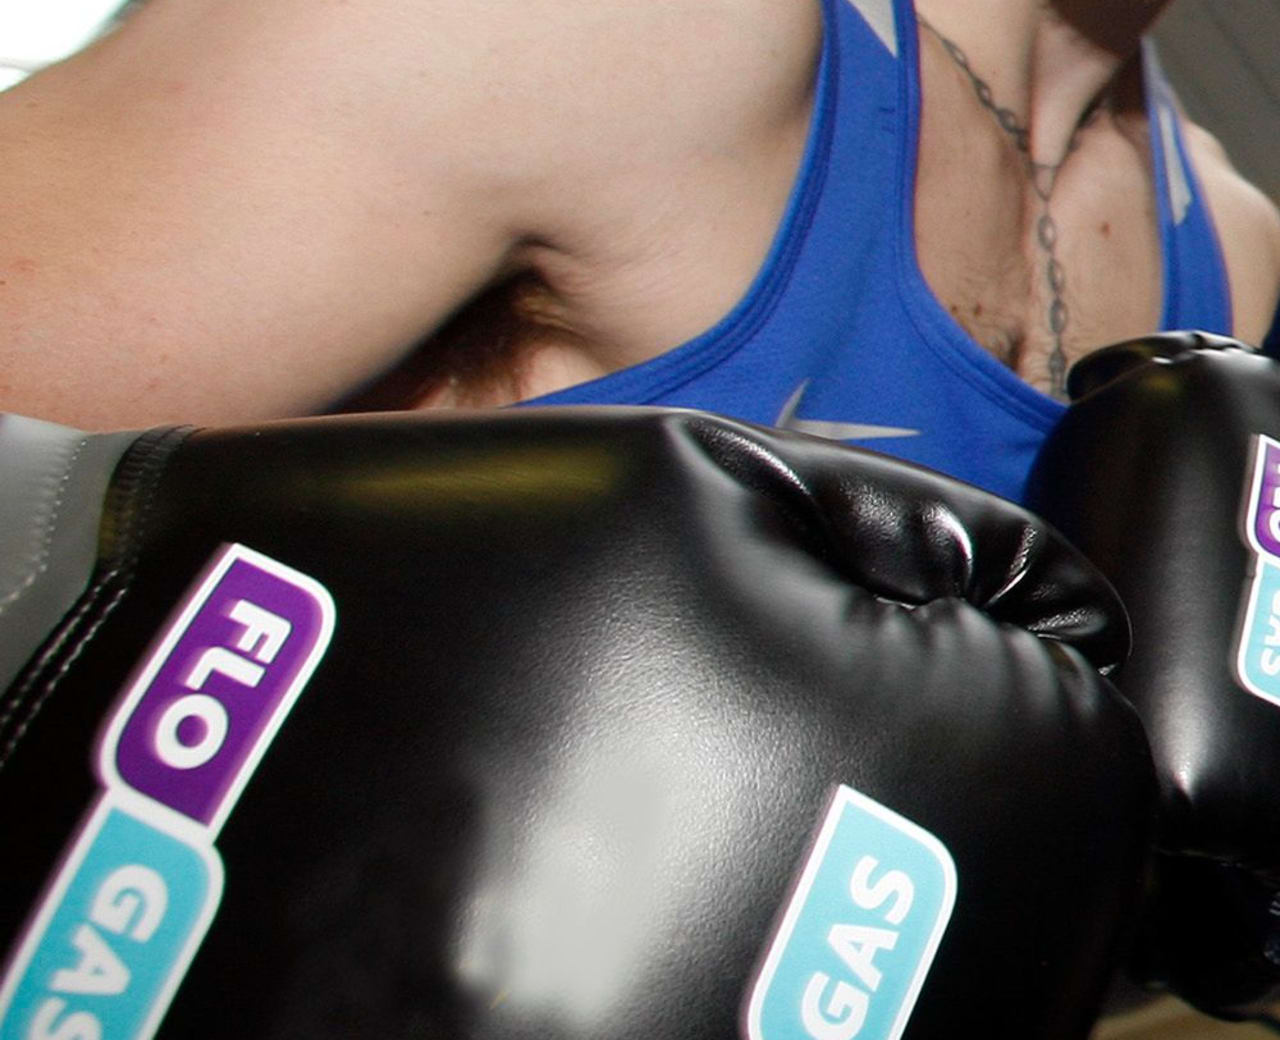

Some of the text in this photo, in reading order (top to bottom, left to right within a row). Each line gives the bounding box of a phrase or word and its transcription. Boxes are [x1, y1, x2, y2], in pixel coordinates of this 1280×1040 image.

[27, 599, 292, 1040] FLO GAS
[801, 855, 915, 1040] GAS
